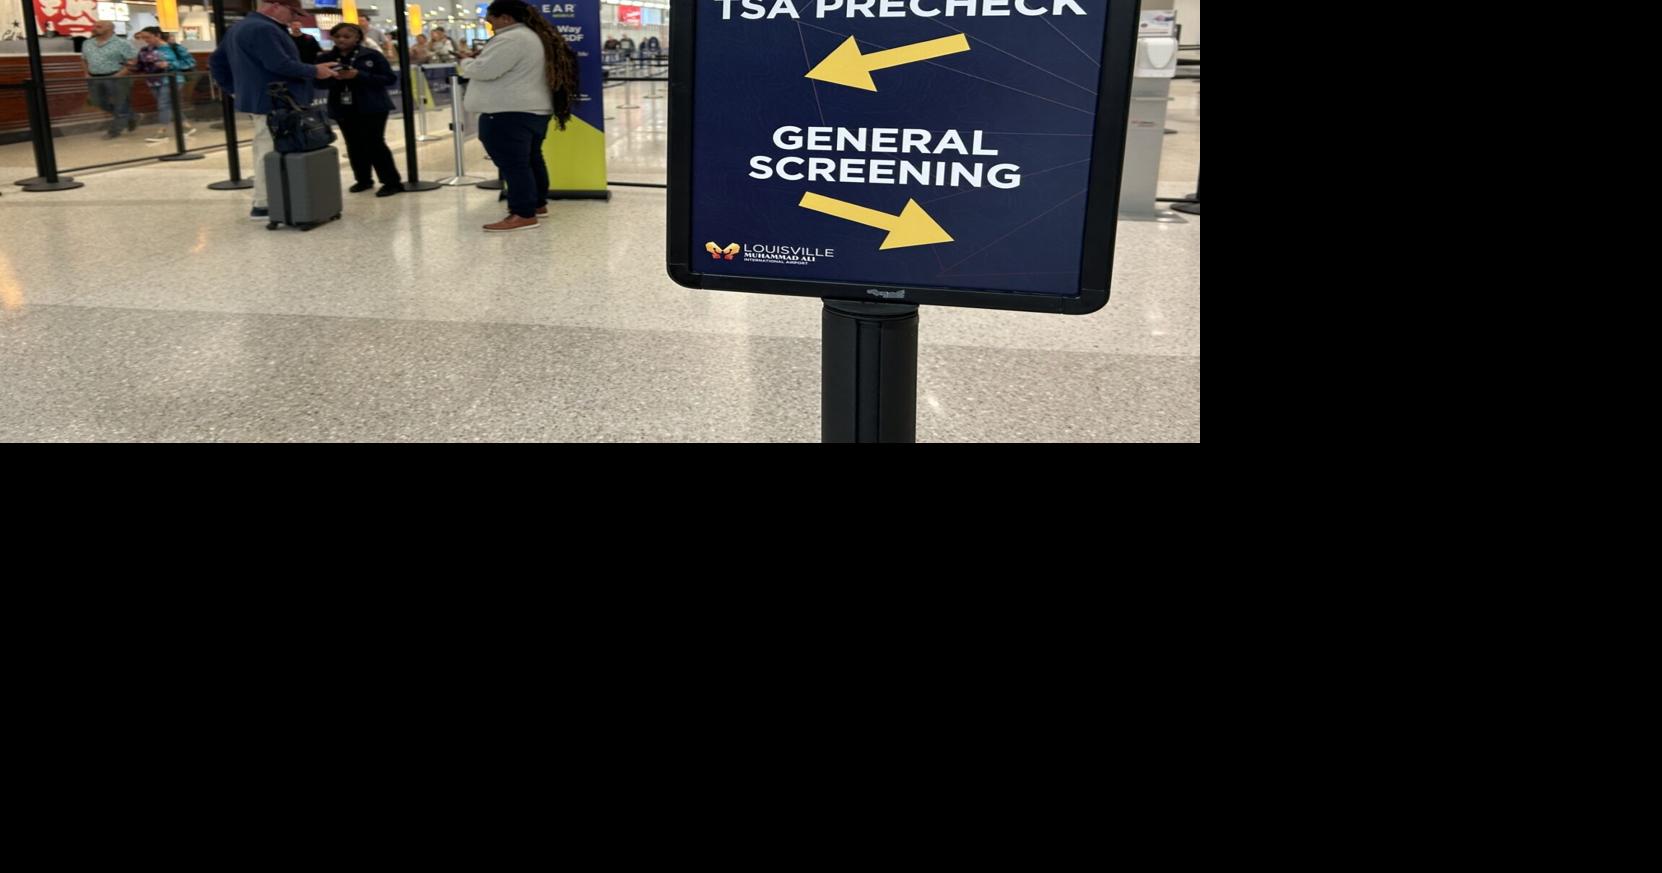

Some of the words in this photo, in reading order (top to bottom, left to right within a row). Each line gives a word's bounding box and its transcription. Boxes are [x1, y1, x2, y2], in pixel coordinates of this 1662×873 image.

[541, 4, 575, 13] EAR
[714, 0, 800, 20] TSA
[816, 0, 1088, 18] PRECHECK
[772, 125, 999, 156] GENERAL
[748, 155, 1021, 189] SCREENING
[743, 243, 834, 258] LOUISVILLE
[744, 252, 799, 261] MUHAMMAD
